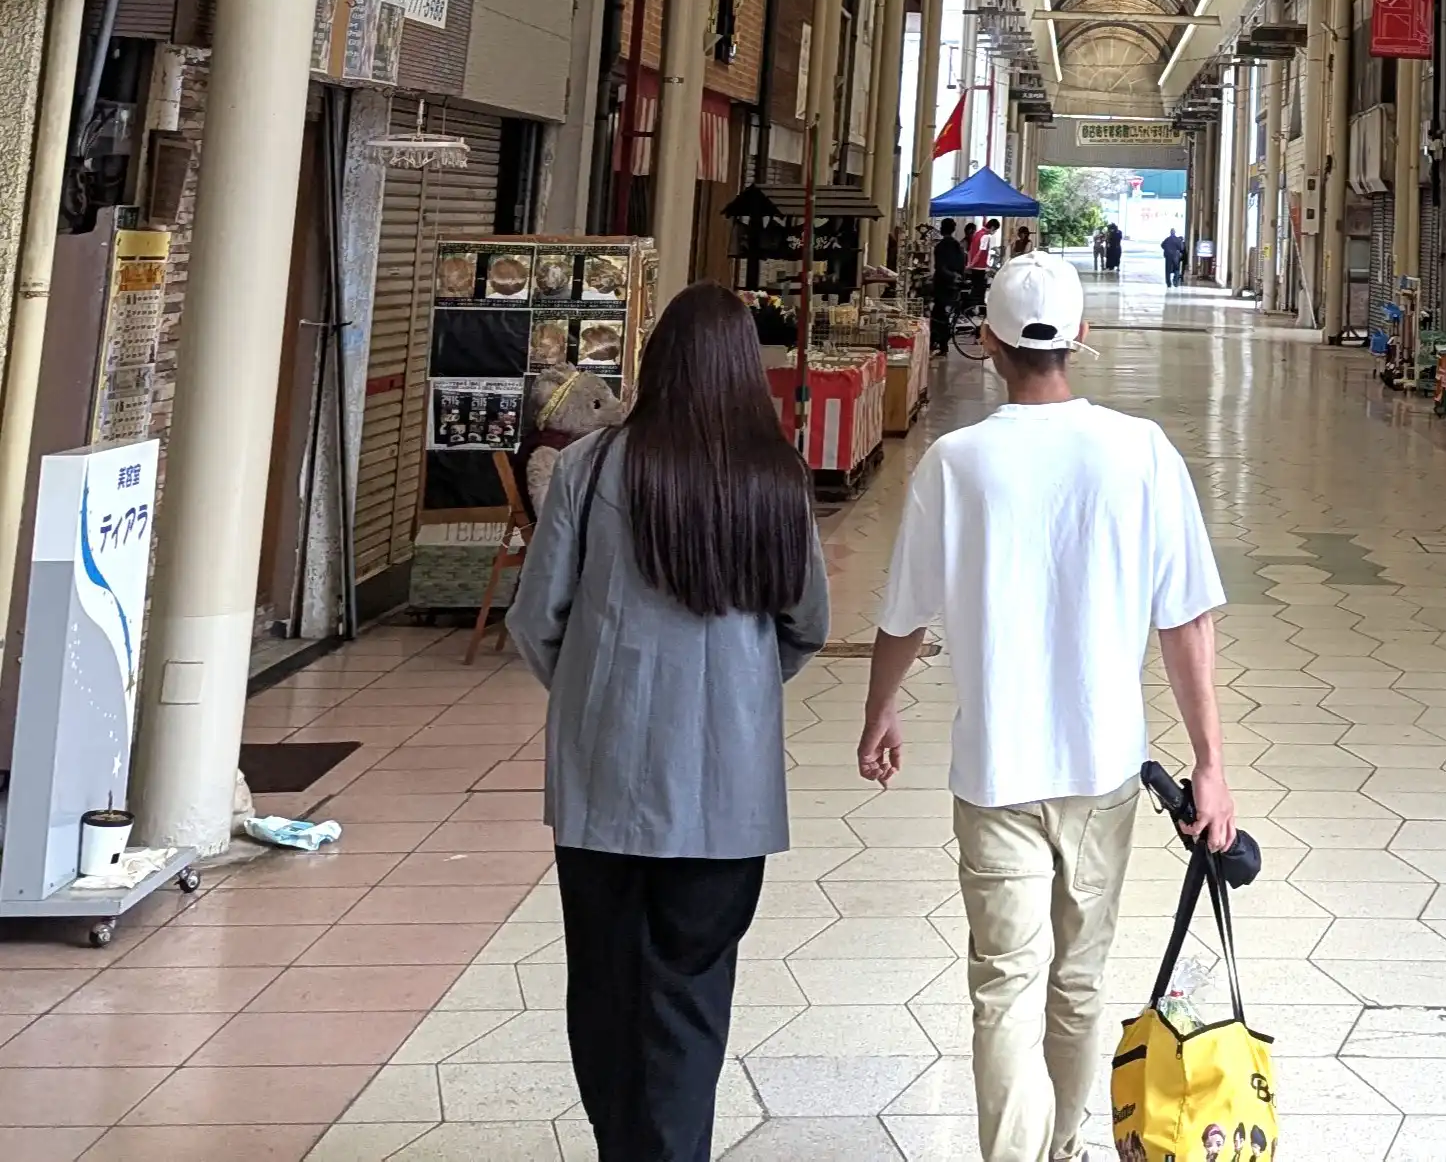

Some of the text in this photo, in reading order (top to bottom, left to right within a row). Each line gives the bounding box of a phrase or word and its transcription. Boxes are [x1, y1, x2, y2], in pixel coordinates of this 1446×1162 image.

[117, 463, 142, 491] 美容室
[99, 503, 149, 553] ティアラ
